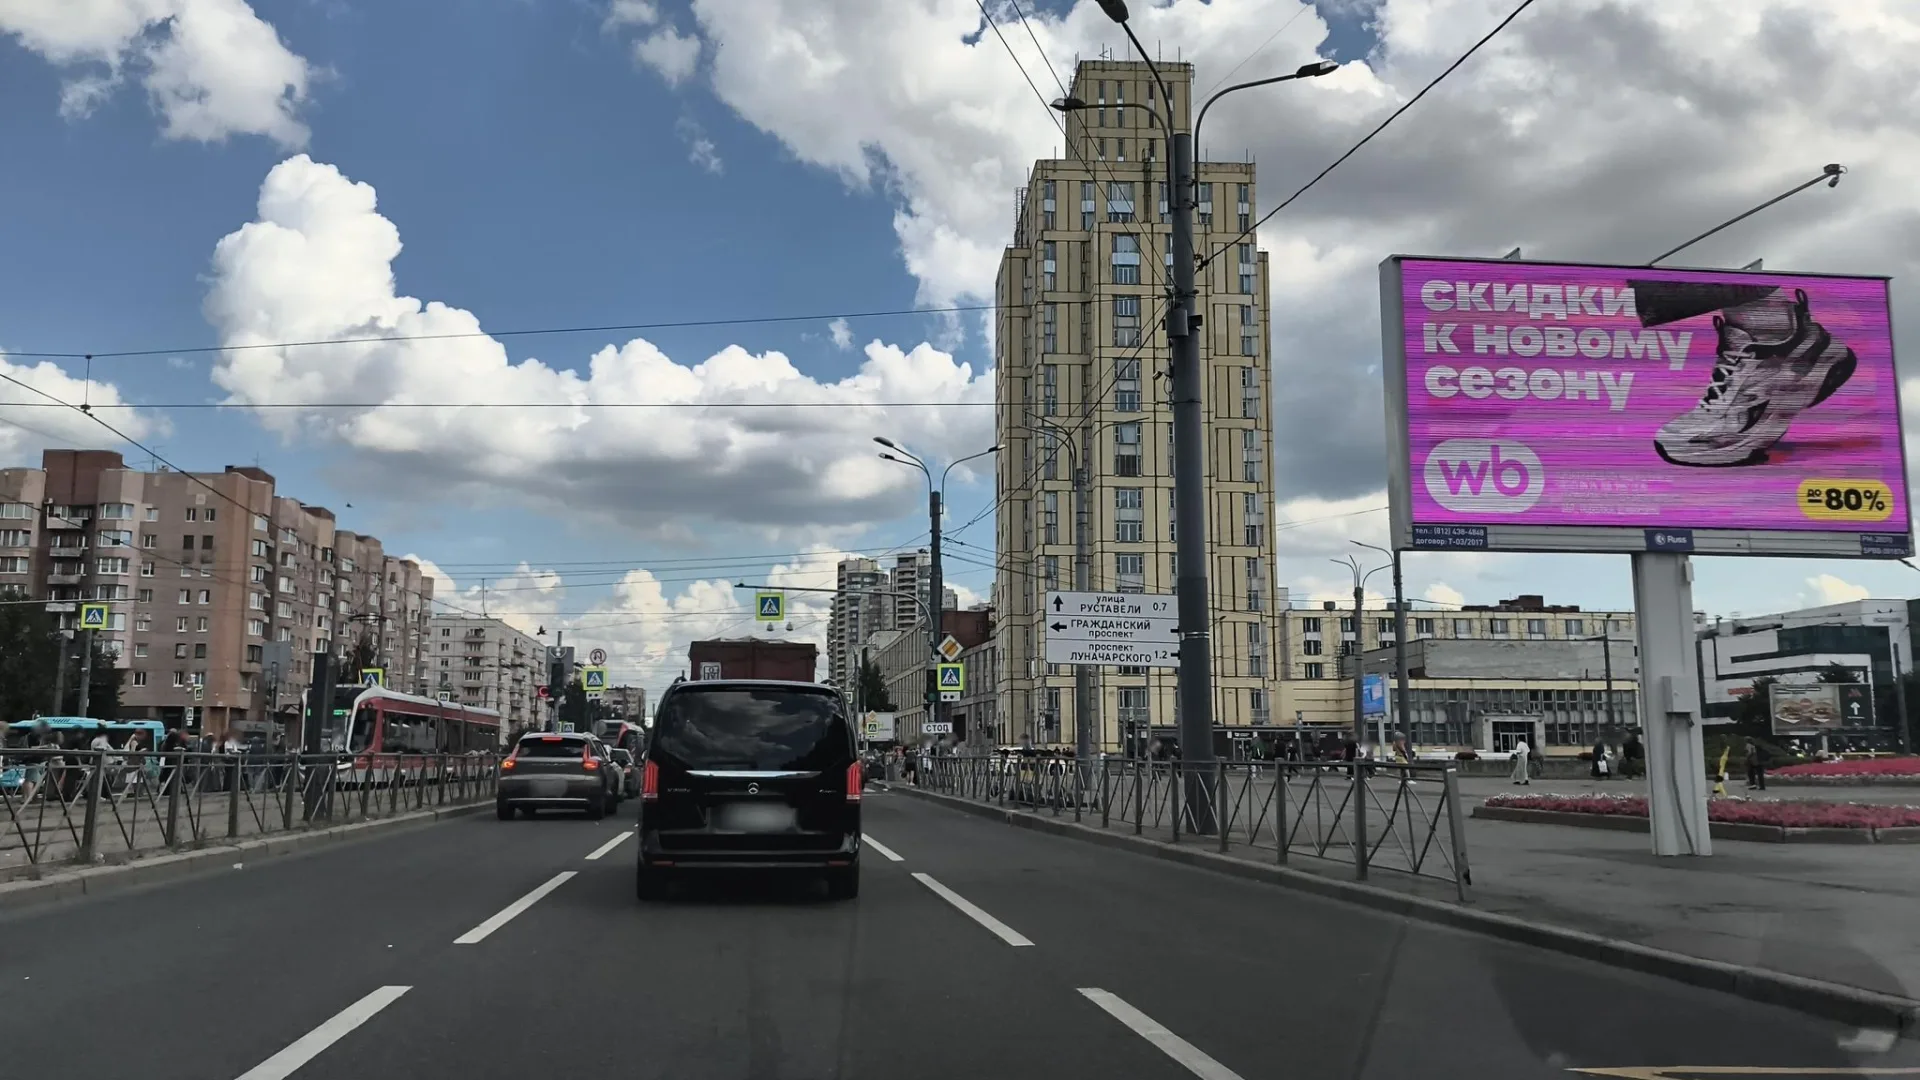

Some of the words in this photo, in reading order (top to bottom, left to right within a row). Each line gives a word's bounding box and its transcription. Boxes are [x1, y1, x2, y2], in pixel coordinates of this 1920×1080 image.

[1437, 445, 1530, 497] wb
[1667, 535, 1687, 543] Russ
[1096, 595, 1125, 603] улица
[1080, 604, 1141, 614] РУСТАВЕЛИ
[1152, 602, 1167, 611] 0.7
[1071, 619, 1151, 630] ГРАЖДАНСКИЙ
[1088, 630, 1134, 639] проспект
[1088, 643, 1134, 652] проспект
[1070, 652, 1152, 663] ЛУНАЧАРСКОГО
[1154, 650, 1168, 659] 1.2
[926, 724, 949, 732] СТОП
